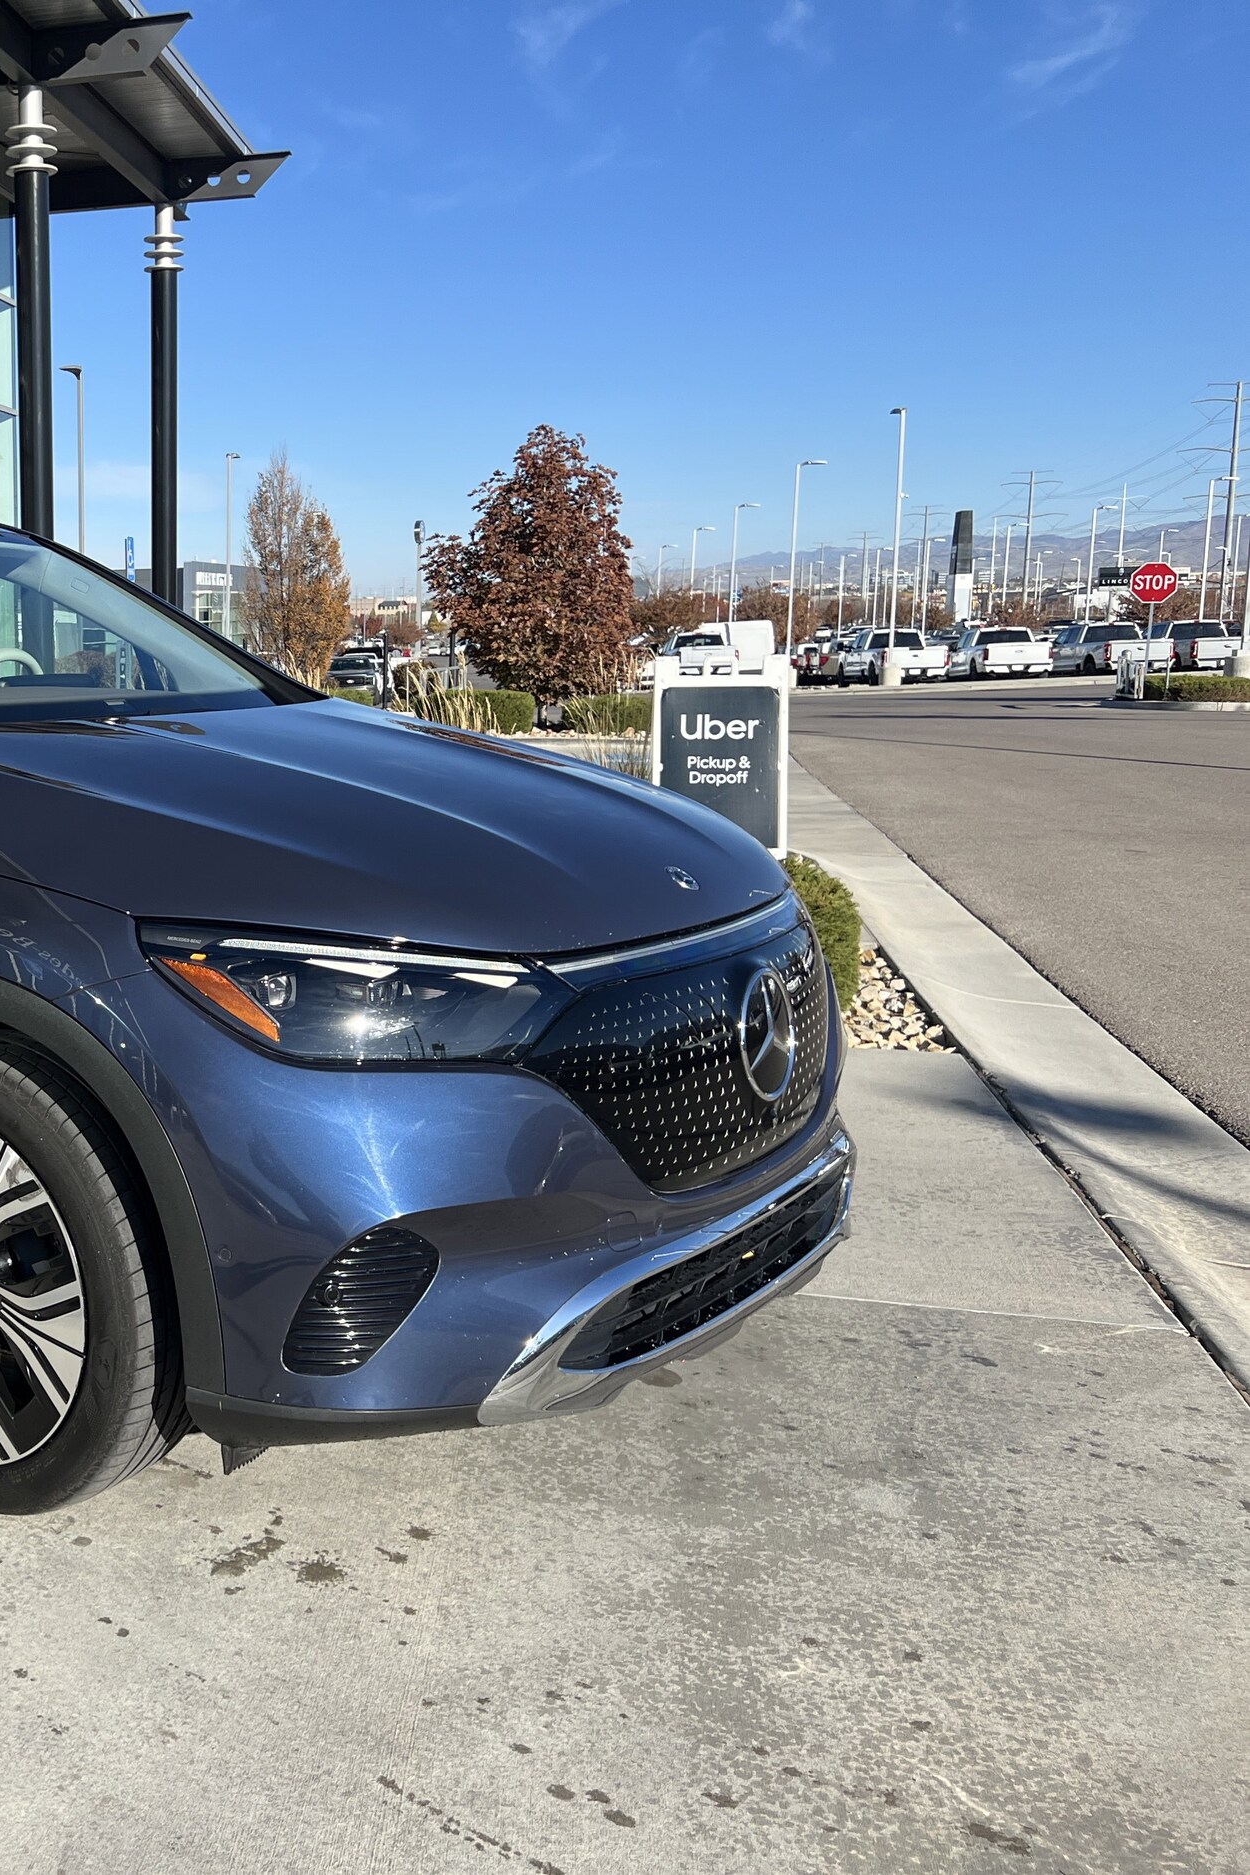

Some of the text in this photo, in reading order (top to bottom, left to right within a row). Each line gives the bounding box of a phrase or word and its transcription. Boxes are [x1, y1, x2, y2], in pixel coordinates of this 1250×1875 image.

[1133, 574, 1175, 590] STOP
[680, 713, 760, 740] Uber
[687, 755, 751, 771] Pickup &
[688, 771, 749, 787] Dropoff
